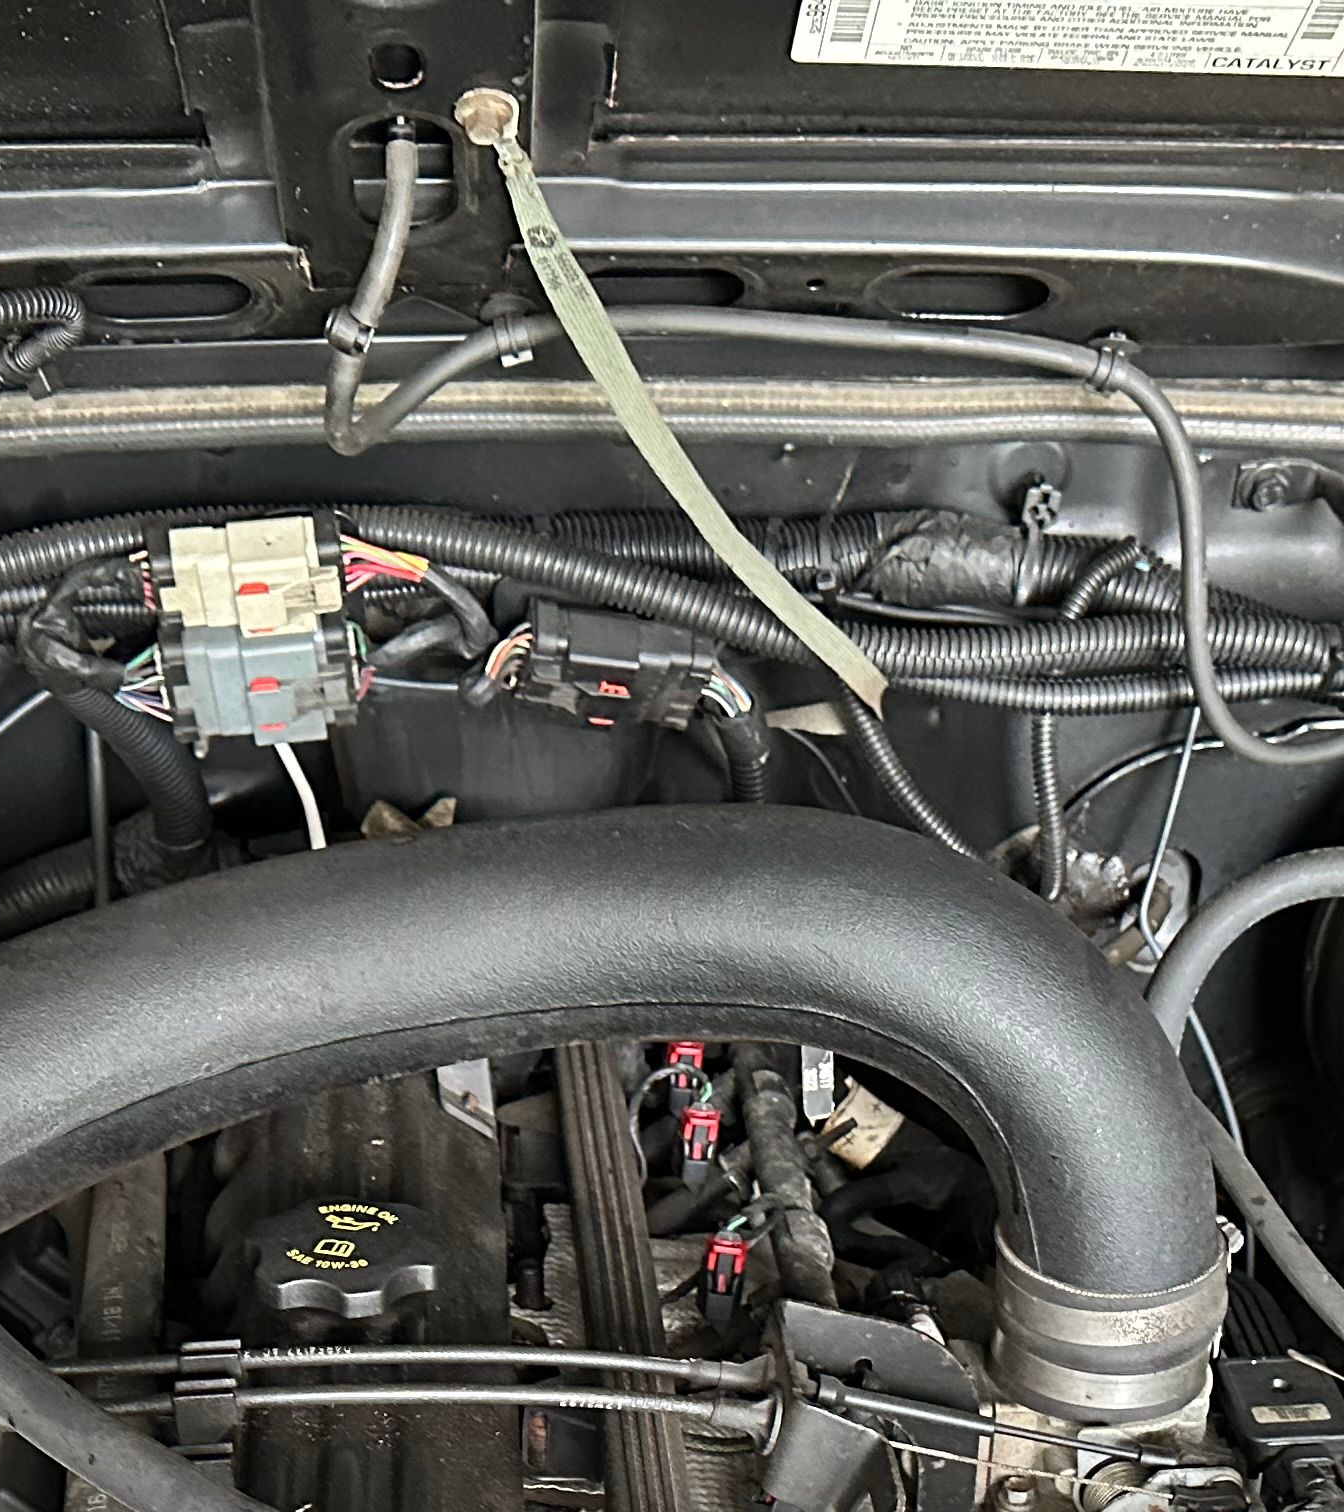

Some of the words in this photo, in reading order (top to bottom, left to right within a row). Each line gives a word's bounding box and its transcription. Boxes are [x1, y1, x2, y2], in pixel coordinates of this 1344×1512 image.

[1211, 56, 1331, 71] CATALYST
[318, 1203, 379, 1216] ENGINE
[378, 1211, 399, 1225] OIL
[286, 1248, 314, 1265] SAE
[315, 1258, 369, 1270] 10W-30
